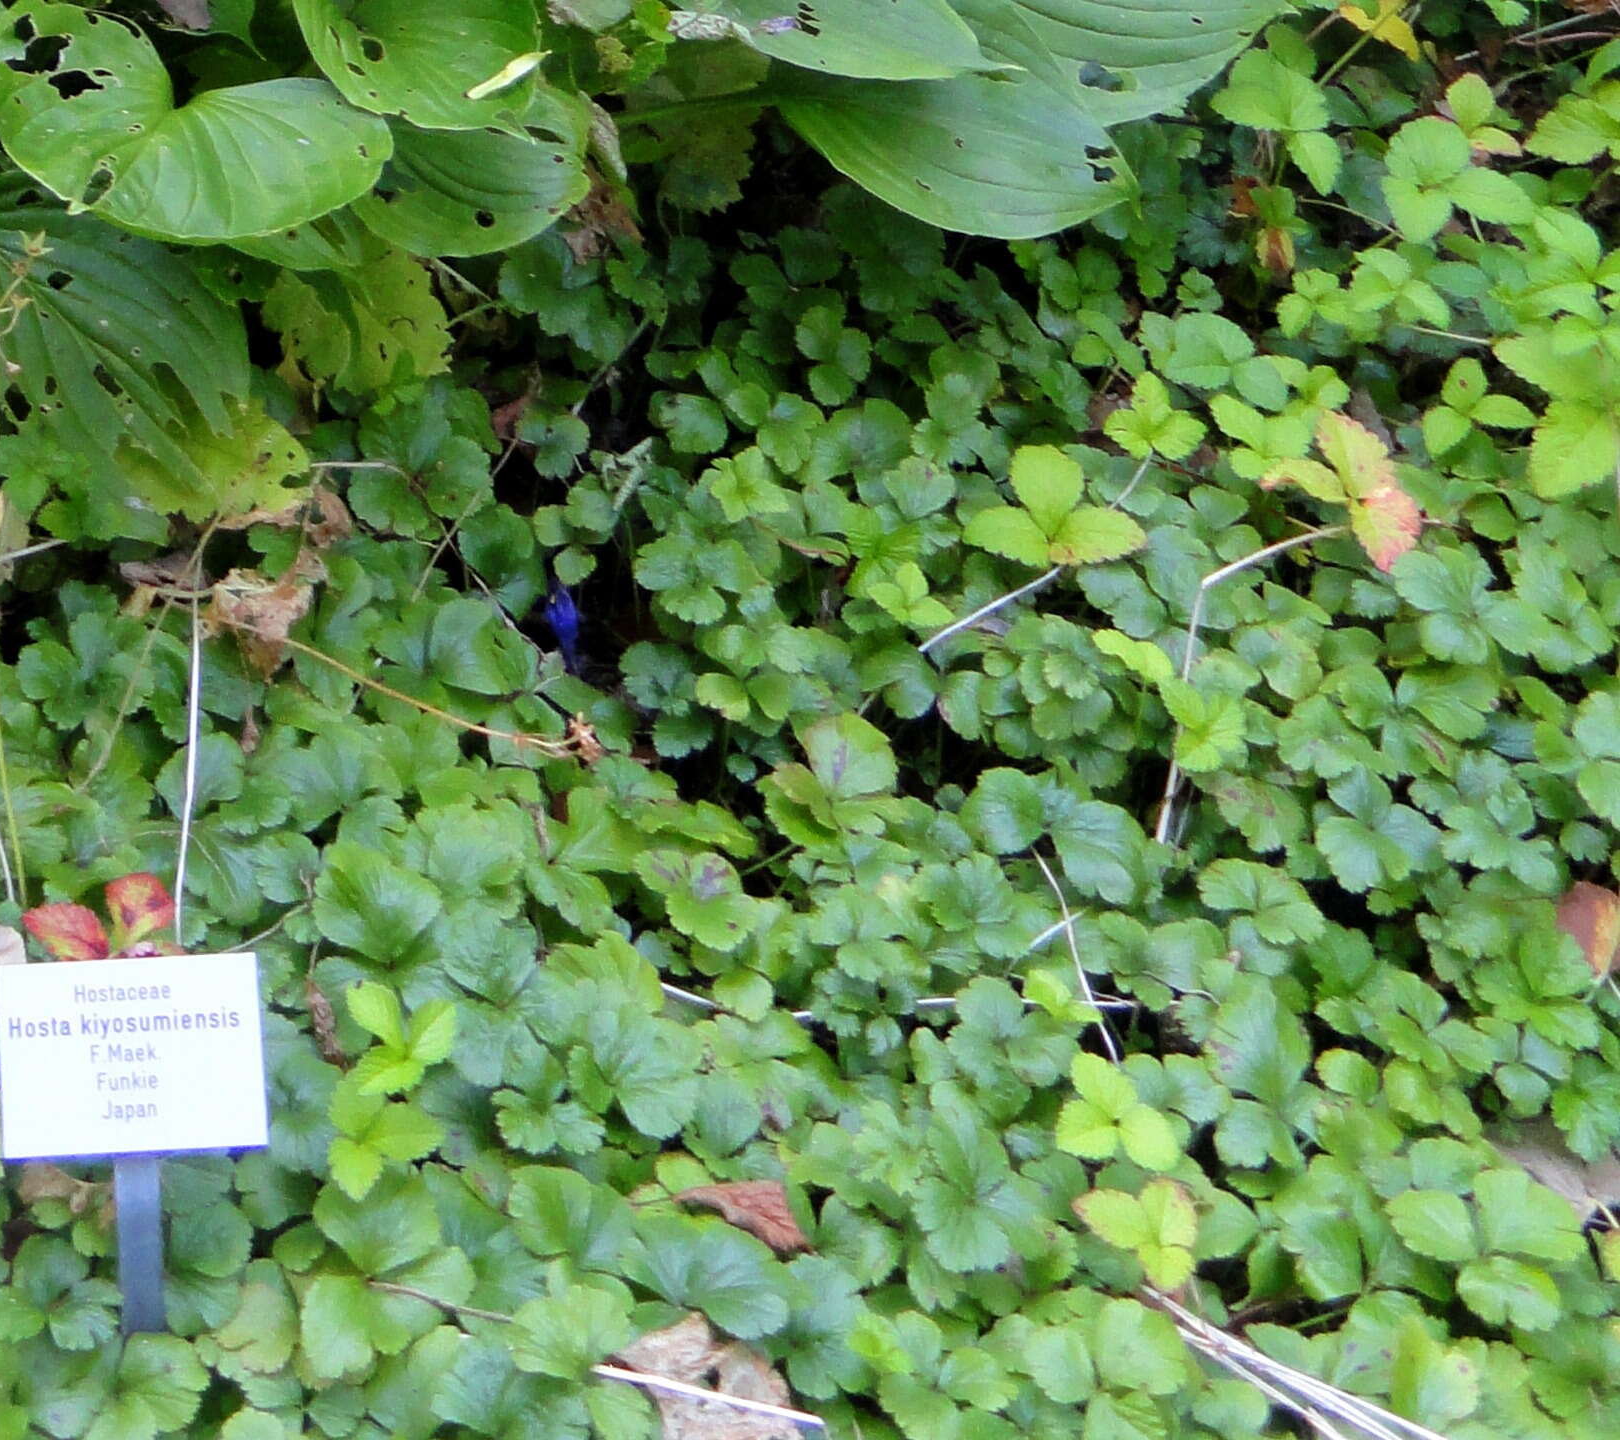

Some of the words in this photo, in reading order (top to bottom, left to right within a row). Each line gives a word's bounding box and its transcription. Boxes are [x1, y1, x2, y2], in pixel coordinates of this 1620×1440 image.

[73, 984, 172, 1004] Hostaceae
[8, 1016, 72, 1039] Hosta
[80, 1006, 241, 1040] kiyosumiensis
[96, 1071, 159, 1092] Funkie
[101, 1099, 158, 1123] Japan
